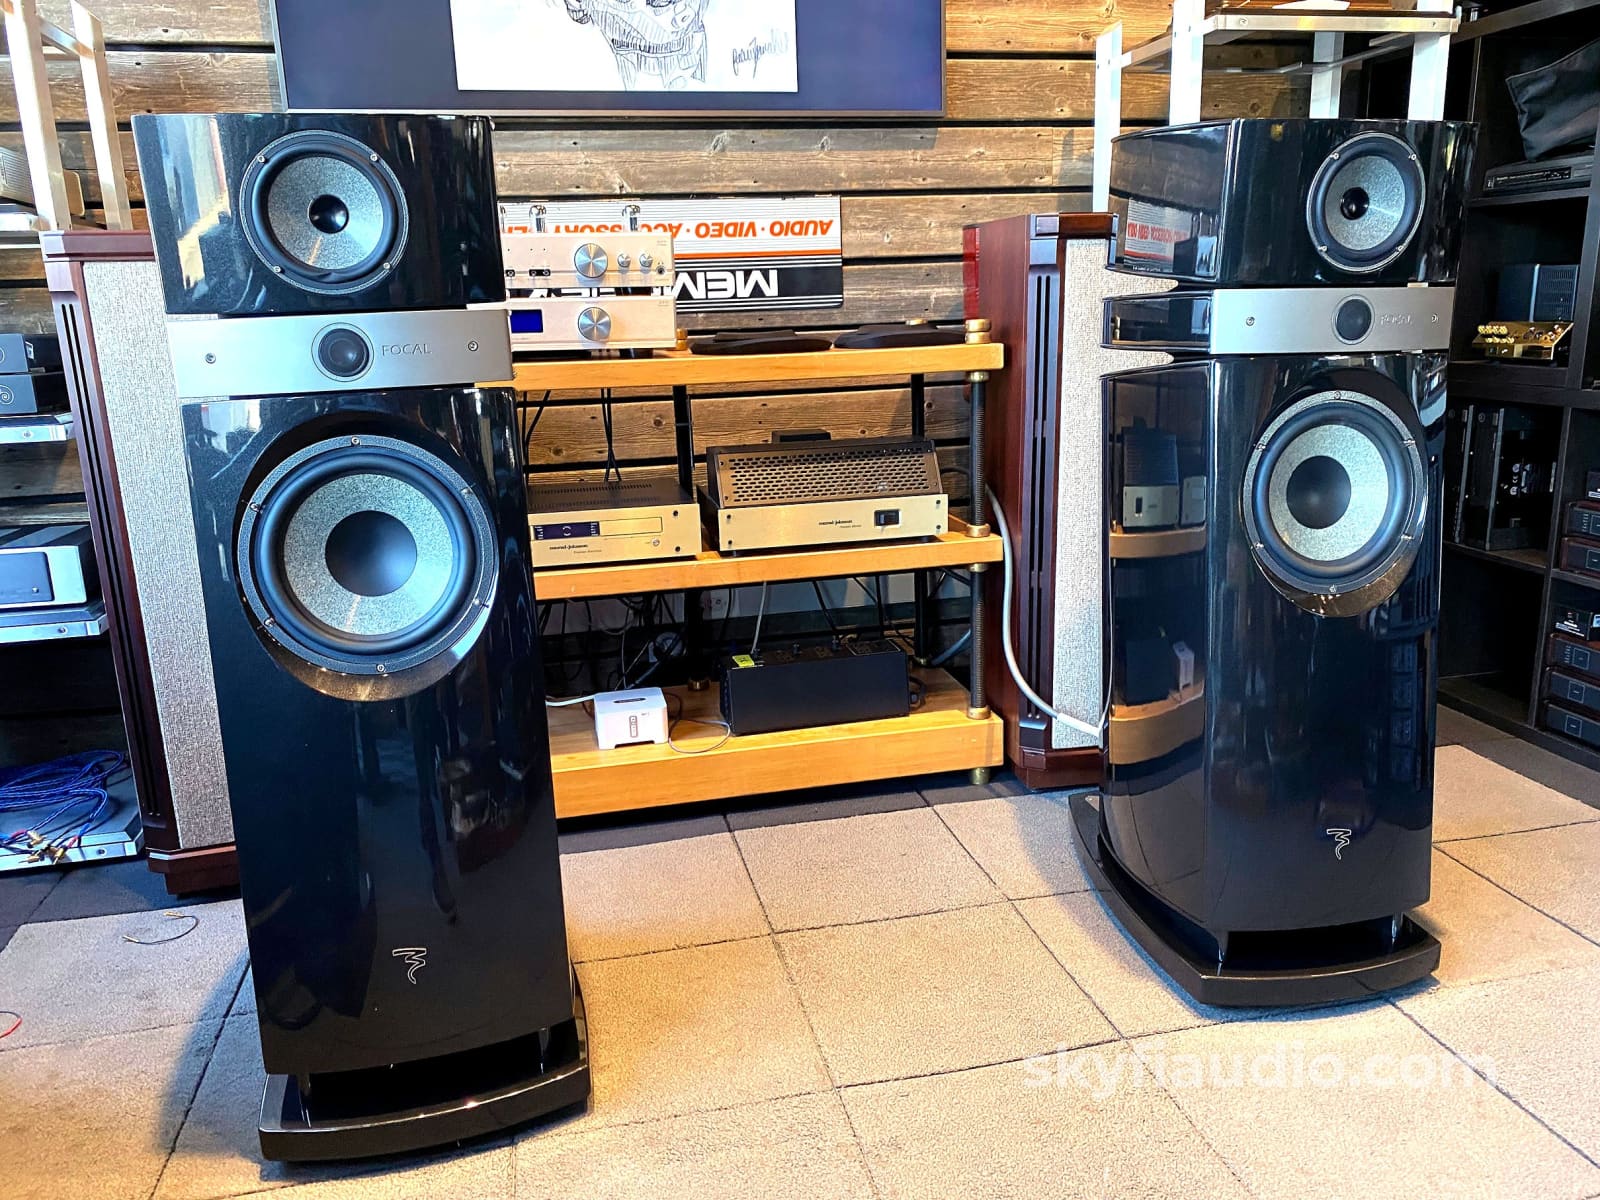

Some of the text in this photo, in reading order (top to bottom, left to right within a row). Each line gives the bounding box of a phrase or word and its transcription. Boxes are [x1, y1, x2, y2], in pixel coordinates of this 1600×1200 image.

[694, 222, 758, 239] VIDEO
[769, 219, 834, 237] AUDIO
[381, 342, 433, 357] FOCAL
